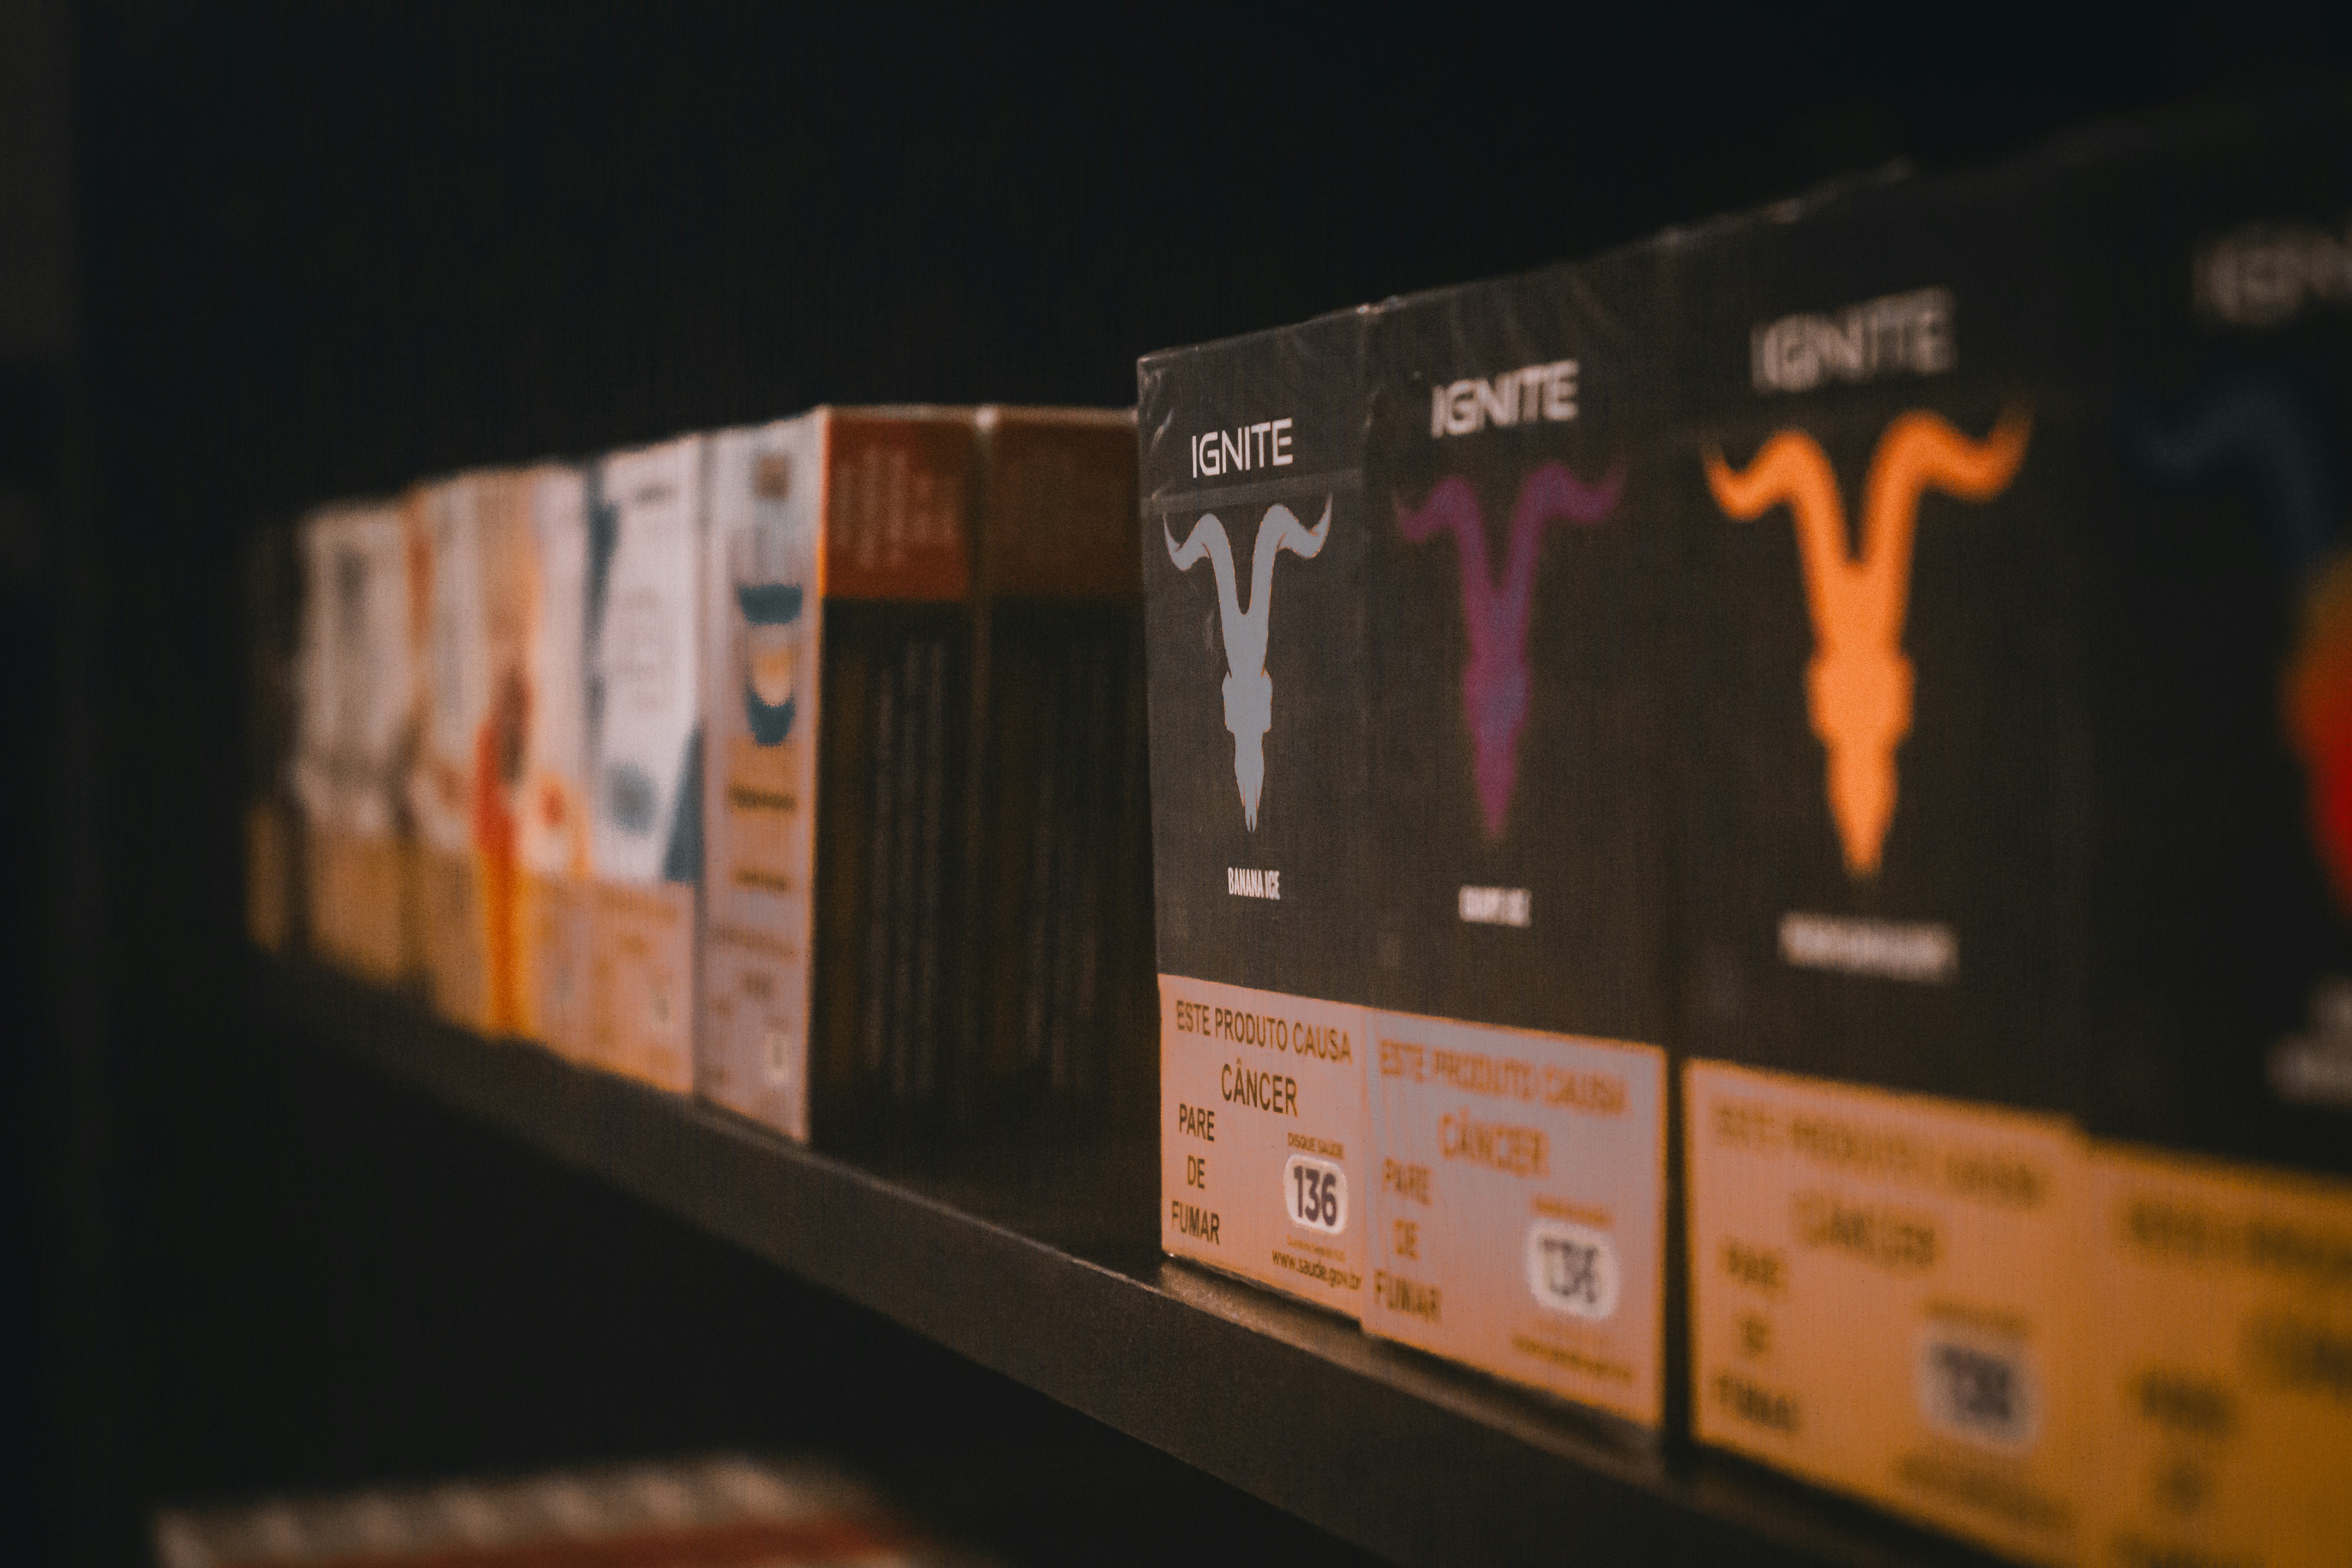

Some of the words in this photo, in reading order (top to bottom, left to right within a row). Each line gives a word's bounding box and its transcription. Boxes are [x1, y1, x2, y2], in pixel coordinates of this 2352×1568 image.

[1431, 358, 1579, 438] IGNITE
[1192, 418, 1293, 478] IGNITE
[1228, 867, 1264, 898] BANANA
[1265, 870, 1281, 900] ICE
[1176, 999, 1211, 1037] ESTE
[1215, 1007, 1288, 1052] PRODUTO
[1293, 1021, 1354, 1065] CAUSA
[1221, 1057, 1298, 1117] CÂNCER
[1179, 1103, 1215, 1142] PARE
[1187, 1154, 1206, 1189] DE
[1293, 1165, 1337, 1227] 136
[1171, 1200, 1220, 1245] FUMAR
